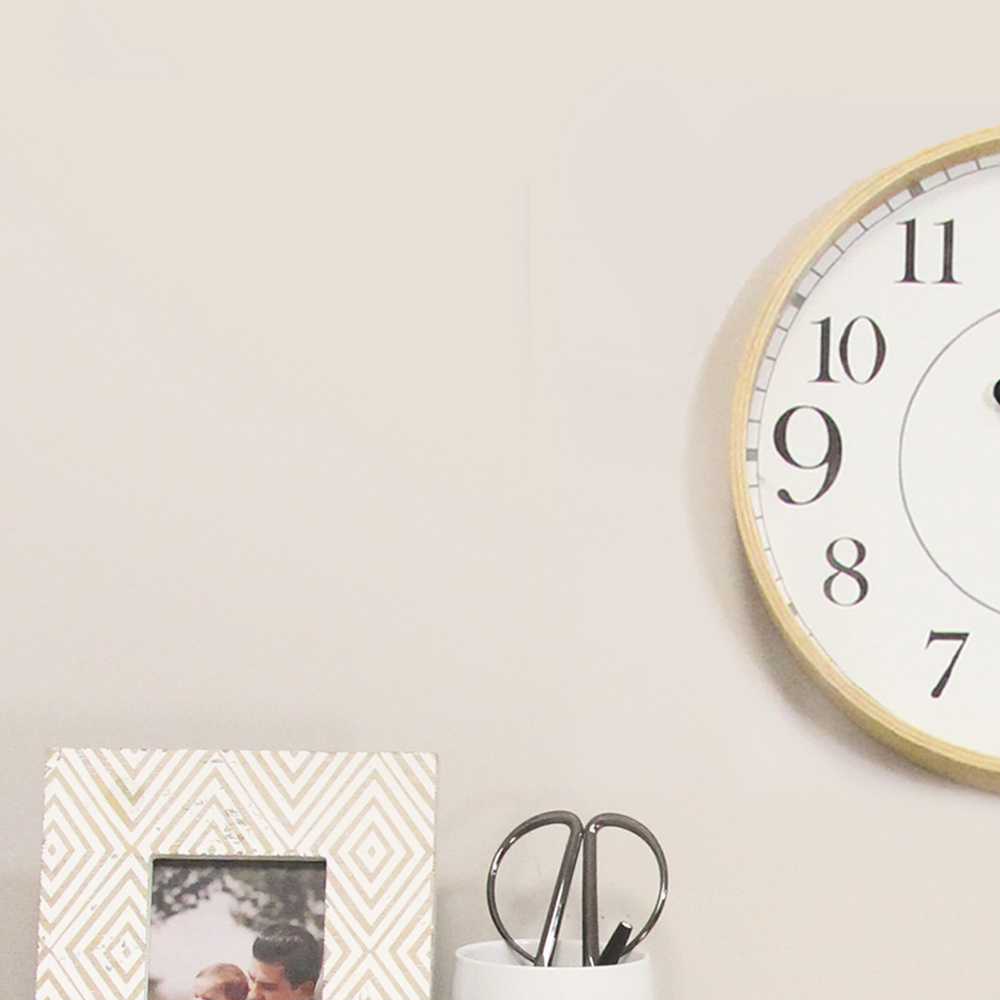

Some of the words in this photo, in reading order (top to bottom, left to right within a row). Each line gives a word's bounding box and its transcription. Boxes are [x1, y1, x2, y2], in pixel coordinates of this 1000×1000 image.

[895, 218, 963, 284] 11
[811, 315, 887, 384] 10
[773, 405, 843, 505] 9
[824, 537, 868, 606] 8
[926, 630, 968, 698] 7
